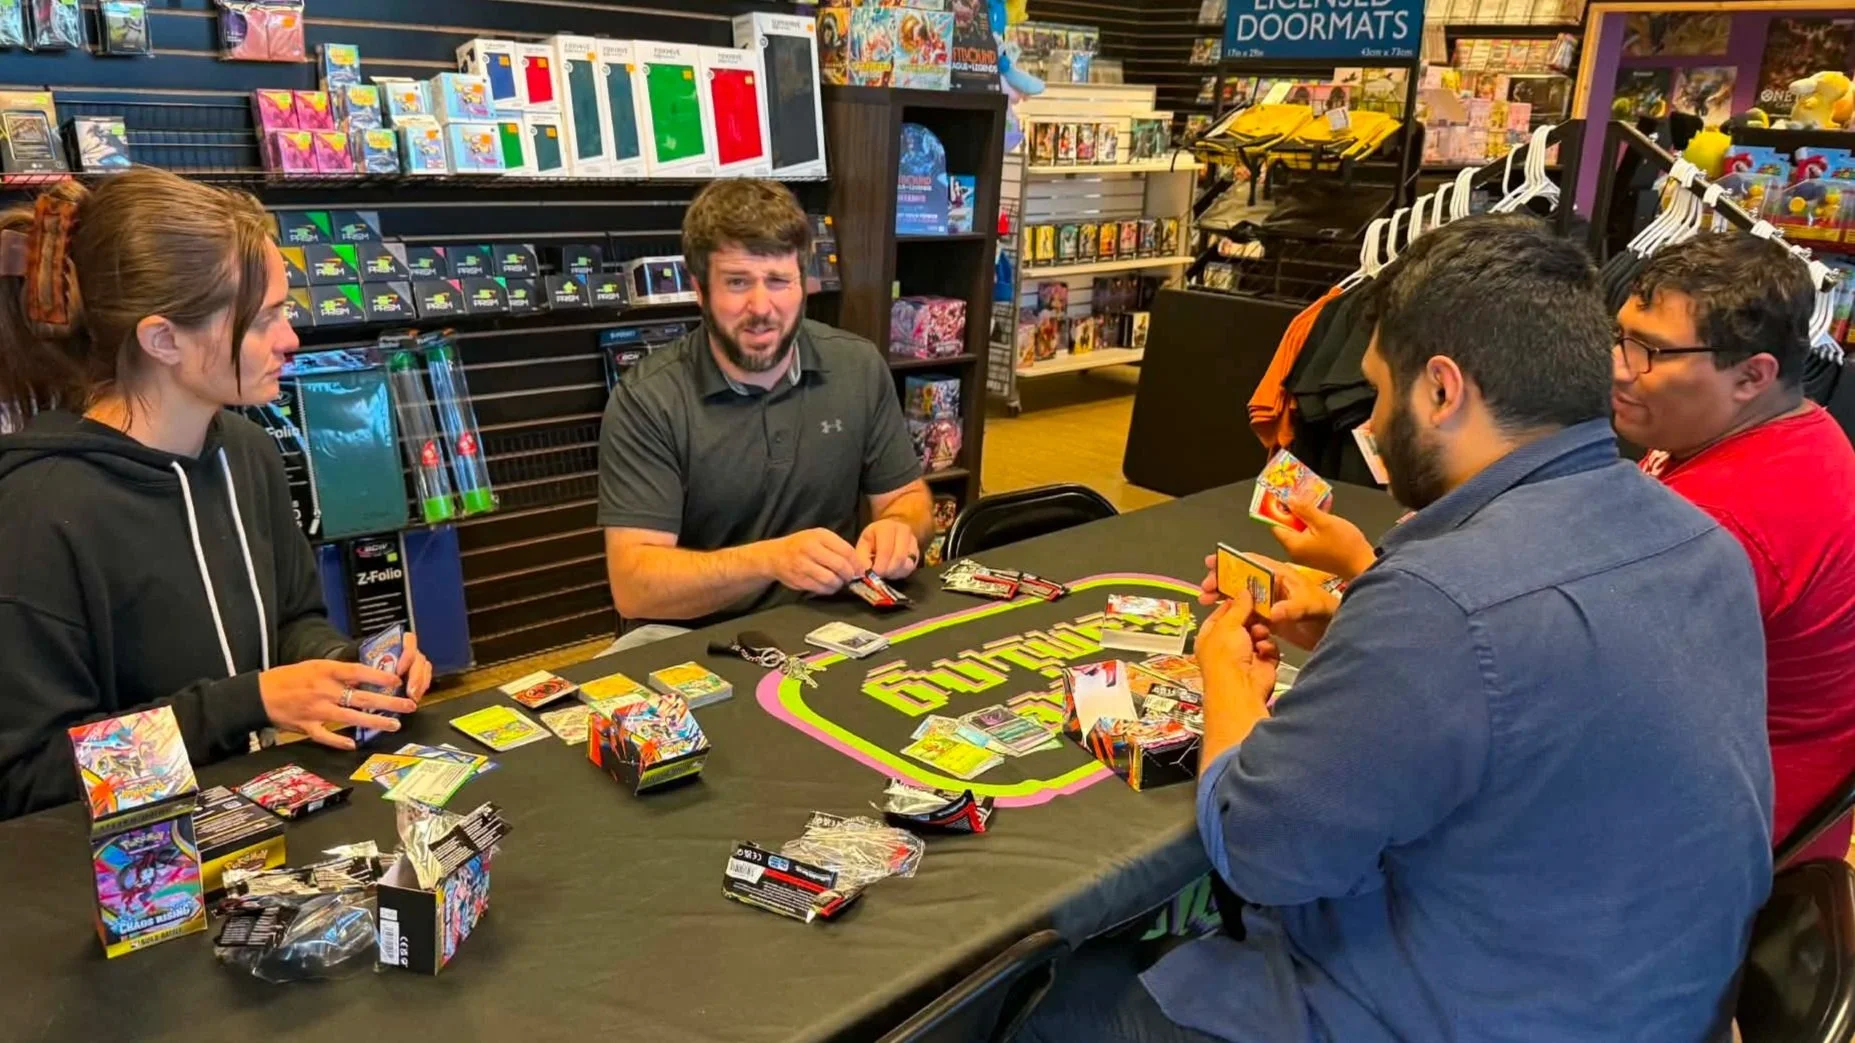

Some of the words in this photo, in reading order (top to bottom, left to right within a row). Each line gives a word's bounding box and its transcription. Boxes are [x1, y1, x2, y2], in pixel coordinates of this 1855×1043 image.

[1237, 11, 1408, 41] DOORMATS
[290, 234, 318, 242] PRISM
[342, 233, 369, 241] PRISM
[316, 267, 345, 276] PRISM
[367, 265, 395, 274] PRISM
[411, 268, 437, 276] PRISM
[457, 266, 483, 275] PRISM
[598, 292, 620, 300] PRISM
[427, 302, 453, 310] PRISM
[474, 299, 499, 307] PRISM
[321, 307, 350, 316] PRISM
[373, 304, 401, 312] PRISM
[357, 567, 402, 585] Z-Folio
[119, 916, 154, 933] CHAOS
[156, 905, 191, 923] RISING
